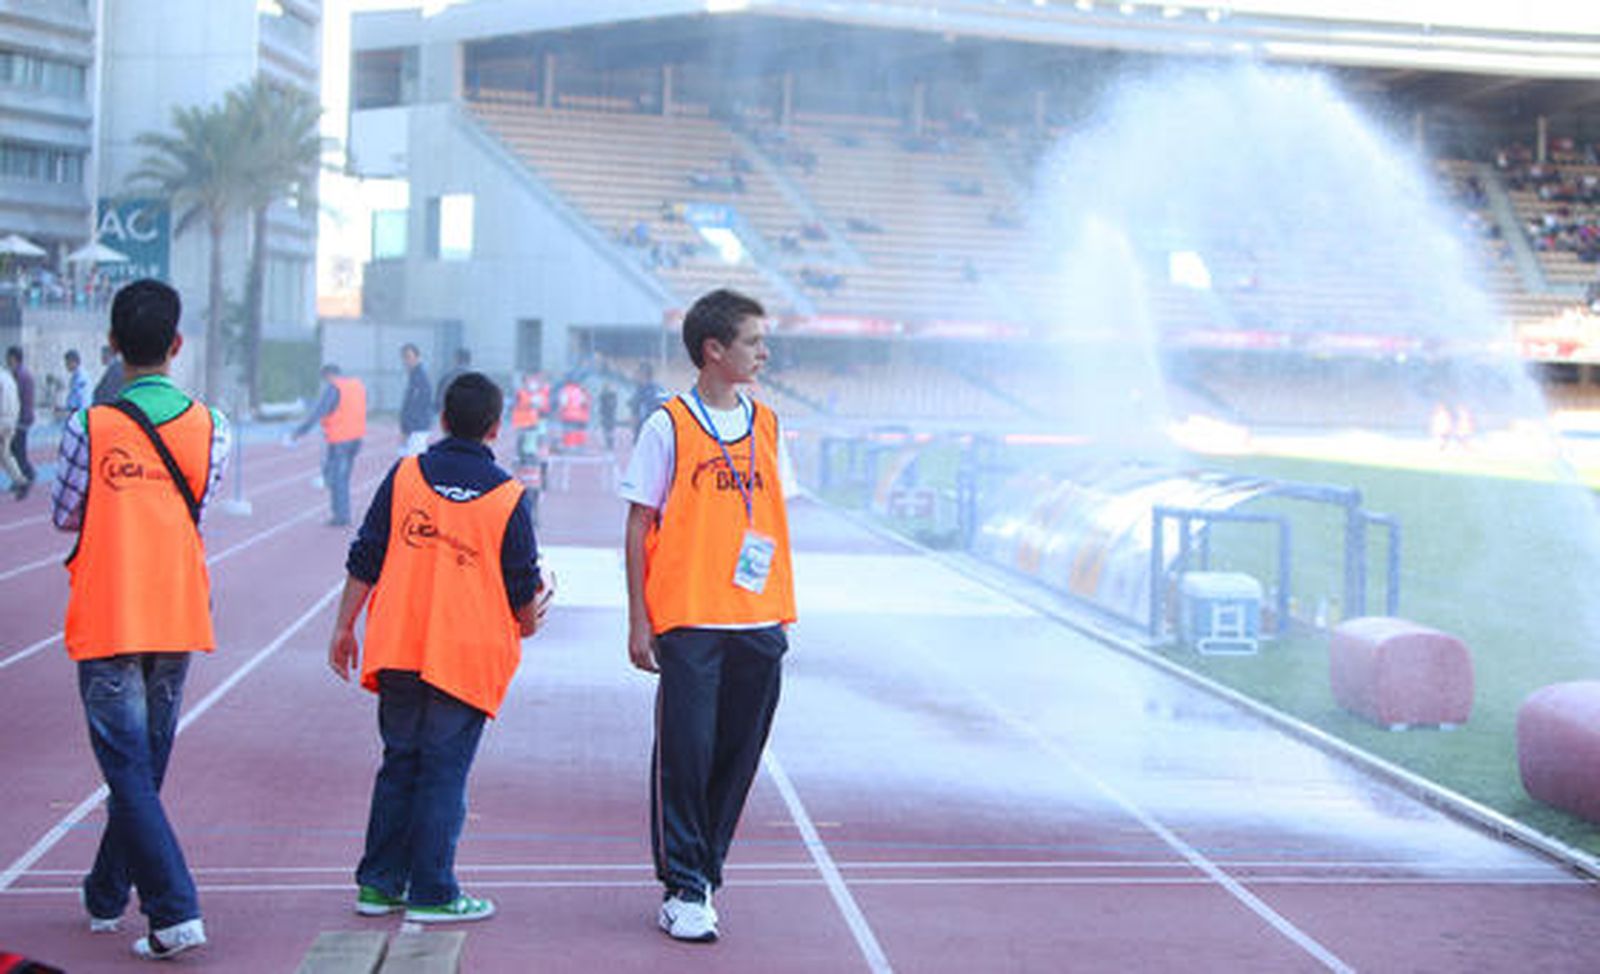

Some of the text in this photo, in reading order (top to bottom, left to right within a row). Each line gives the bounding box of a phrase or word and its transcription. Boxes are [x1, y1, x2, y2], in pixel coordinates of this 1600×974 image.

[99, 208, 159, 241] AC
[108, 463, 143, 478] LIGA
[717, 471, 763, 490] BBVA
